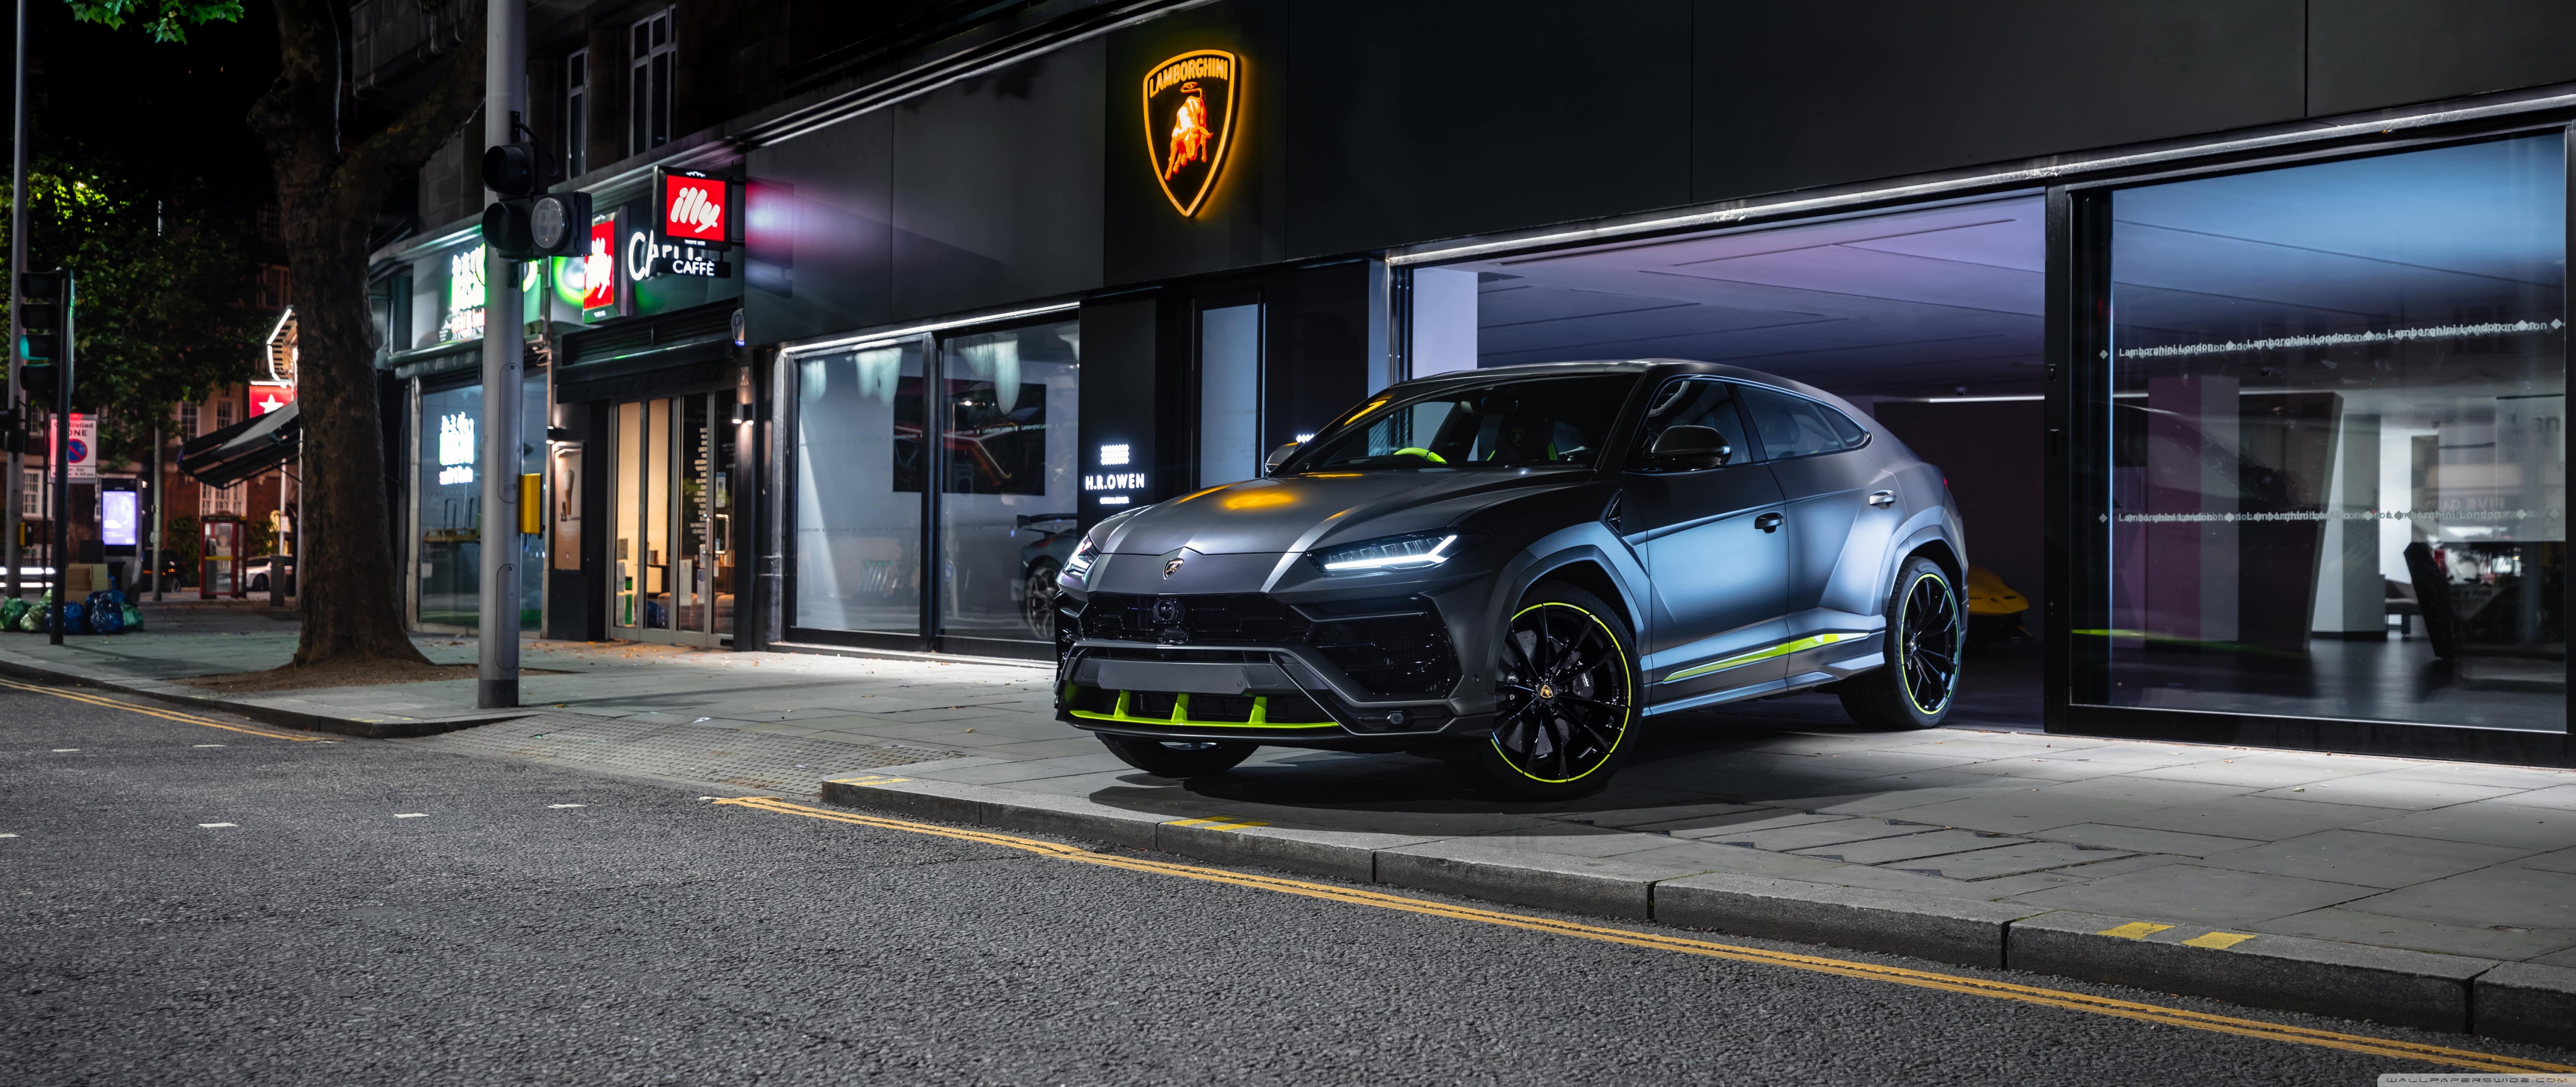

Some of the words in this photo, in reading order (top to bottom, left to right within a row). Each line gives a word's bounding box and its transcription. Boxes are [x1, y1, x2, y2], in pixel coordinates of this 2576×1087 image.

[1149, 57, 1228, 98] LAMBORGHINI
[670, 187, 720, 233] illy
[673, 260, 714, 276] CAFFÈ
[2388, 325, 2456, 338] Lamborghini
[2247, 334, 2309, 347] Lamborghini
[2119, 344, 2176, 357] Lamborghini
[2119, 513, 2176, 523] Lamborghini
